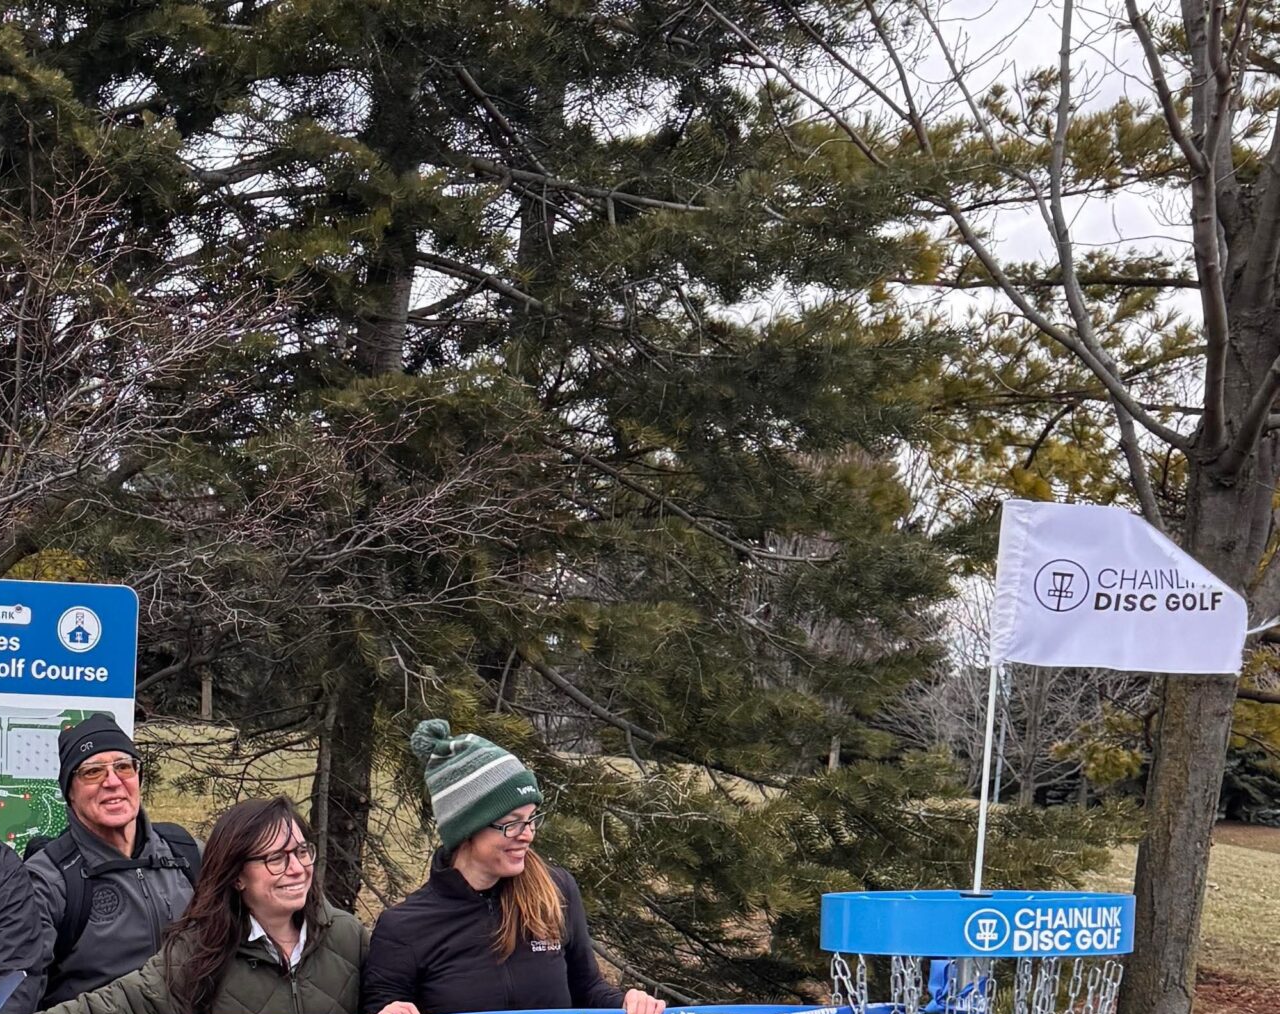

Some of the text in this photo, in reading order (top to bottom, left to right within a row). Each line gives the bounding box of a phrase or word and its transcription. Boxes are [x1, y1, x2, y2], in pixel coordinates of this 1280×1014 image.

[1097, 568, 1214, 590] CHAINL
[1093, 592, 1223, 612] DISC GOLF
[31, 660, 109, 682] Course
[1013, 906, 1122, 929] CHAINLINK
[1013, 928, 1121, 951] DISC GOLF
